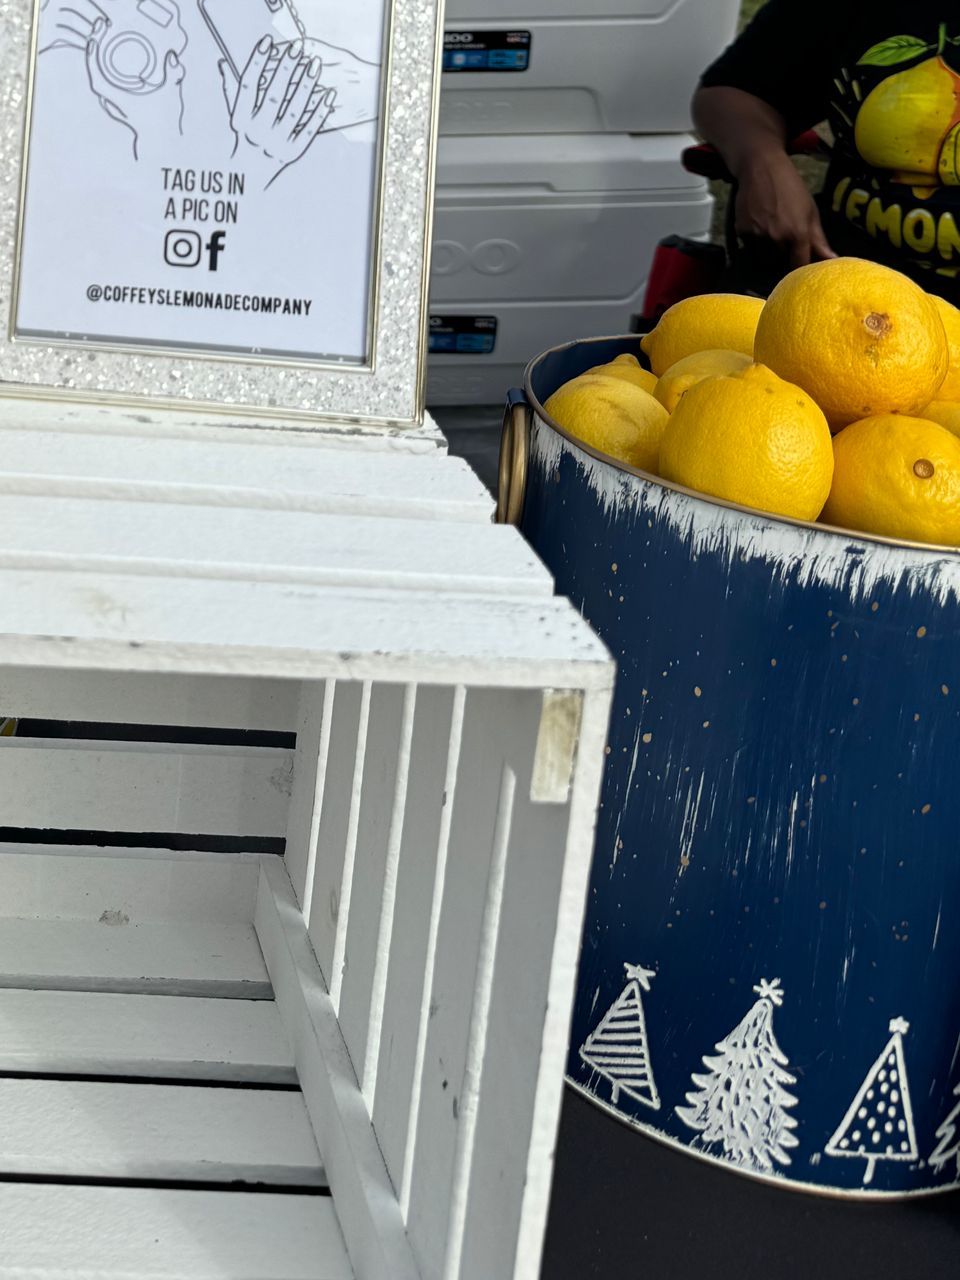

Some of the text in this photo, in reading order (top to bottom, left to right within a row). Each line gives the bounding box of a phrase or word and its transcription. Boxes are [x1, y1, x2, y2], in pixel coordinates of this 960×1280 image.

[161, 167, 245, 195] TAG US IN
[164, 197, 238, 224] A PIC ON
[86, 284, 312, 316] @COFFEYSLEMONADECOMPANY
